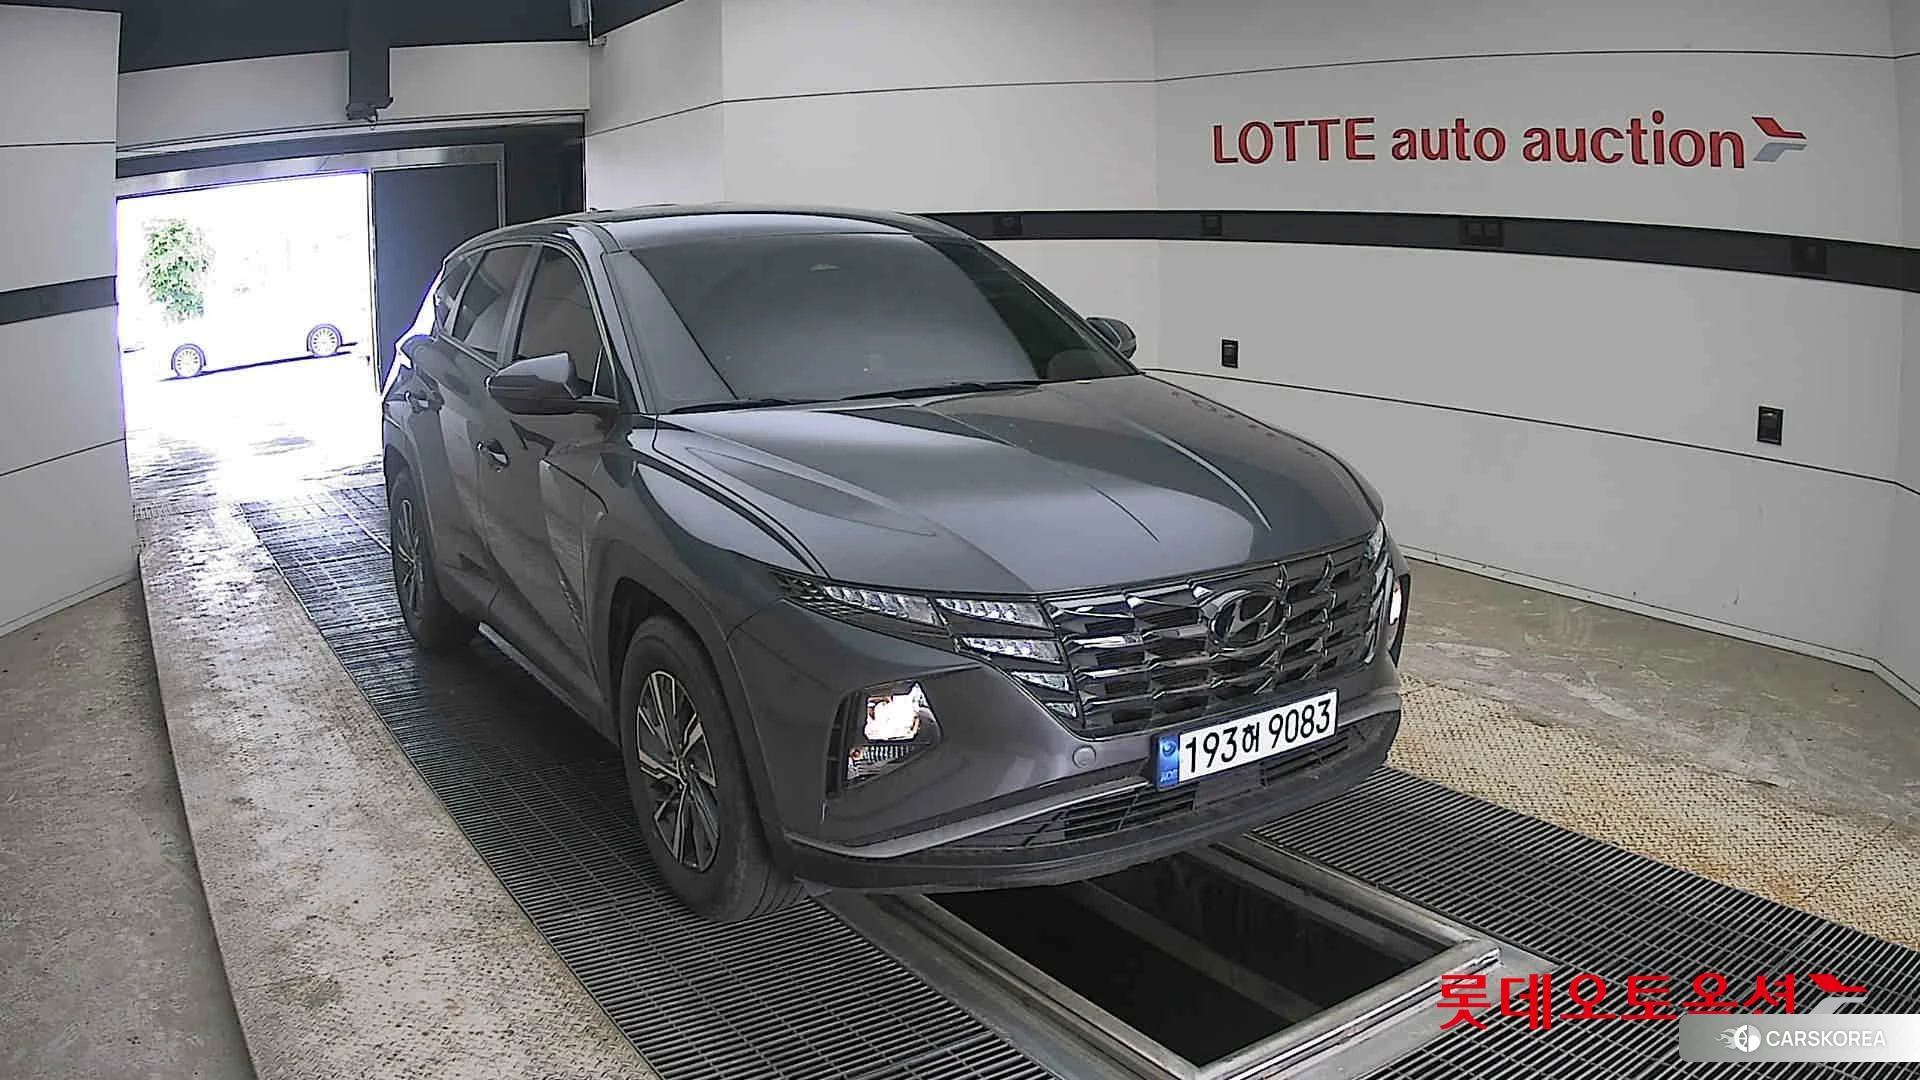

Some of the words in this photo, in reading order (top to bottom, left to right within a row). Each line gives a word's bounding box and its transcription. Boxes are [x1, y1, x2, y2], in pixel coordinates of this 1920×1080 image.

[1212, 116, 1376, 164] LOTTE
[1391, 117, 1506, 163] auto
[1523, 111, 1745, 168] auction
[1185, 722, 1260, 773] 193허
[1268, 699, 1331, 749] 9083
